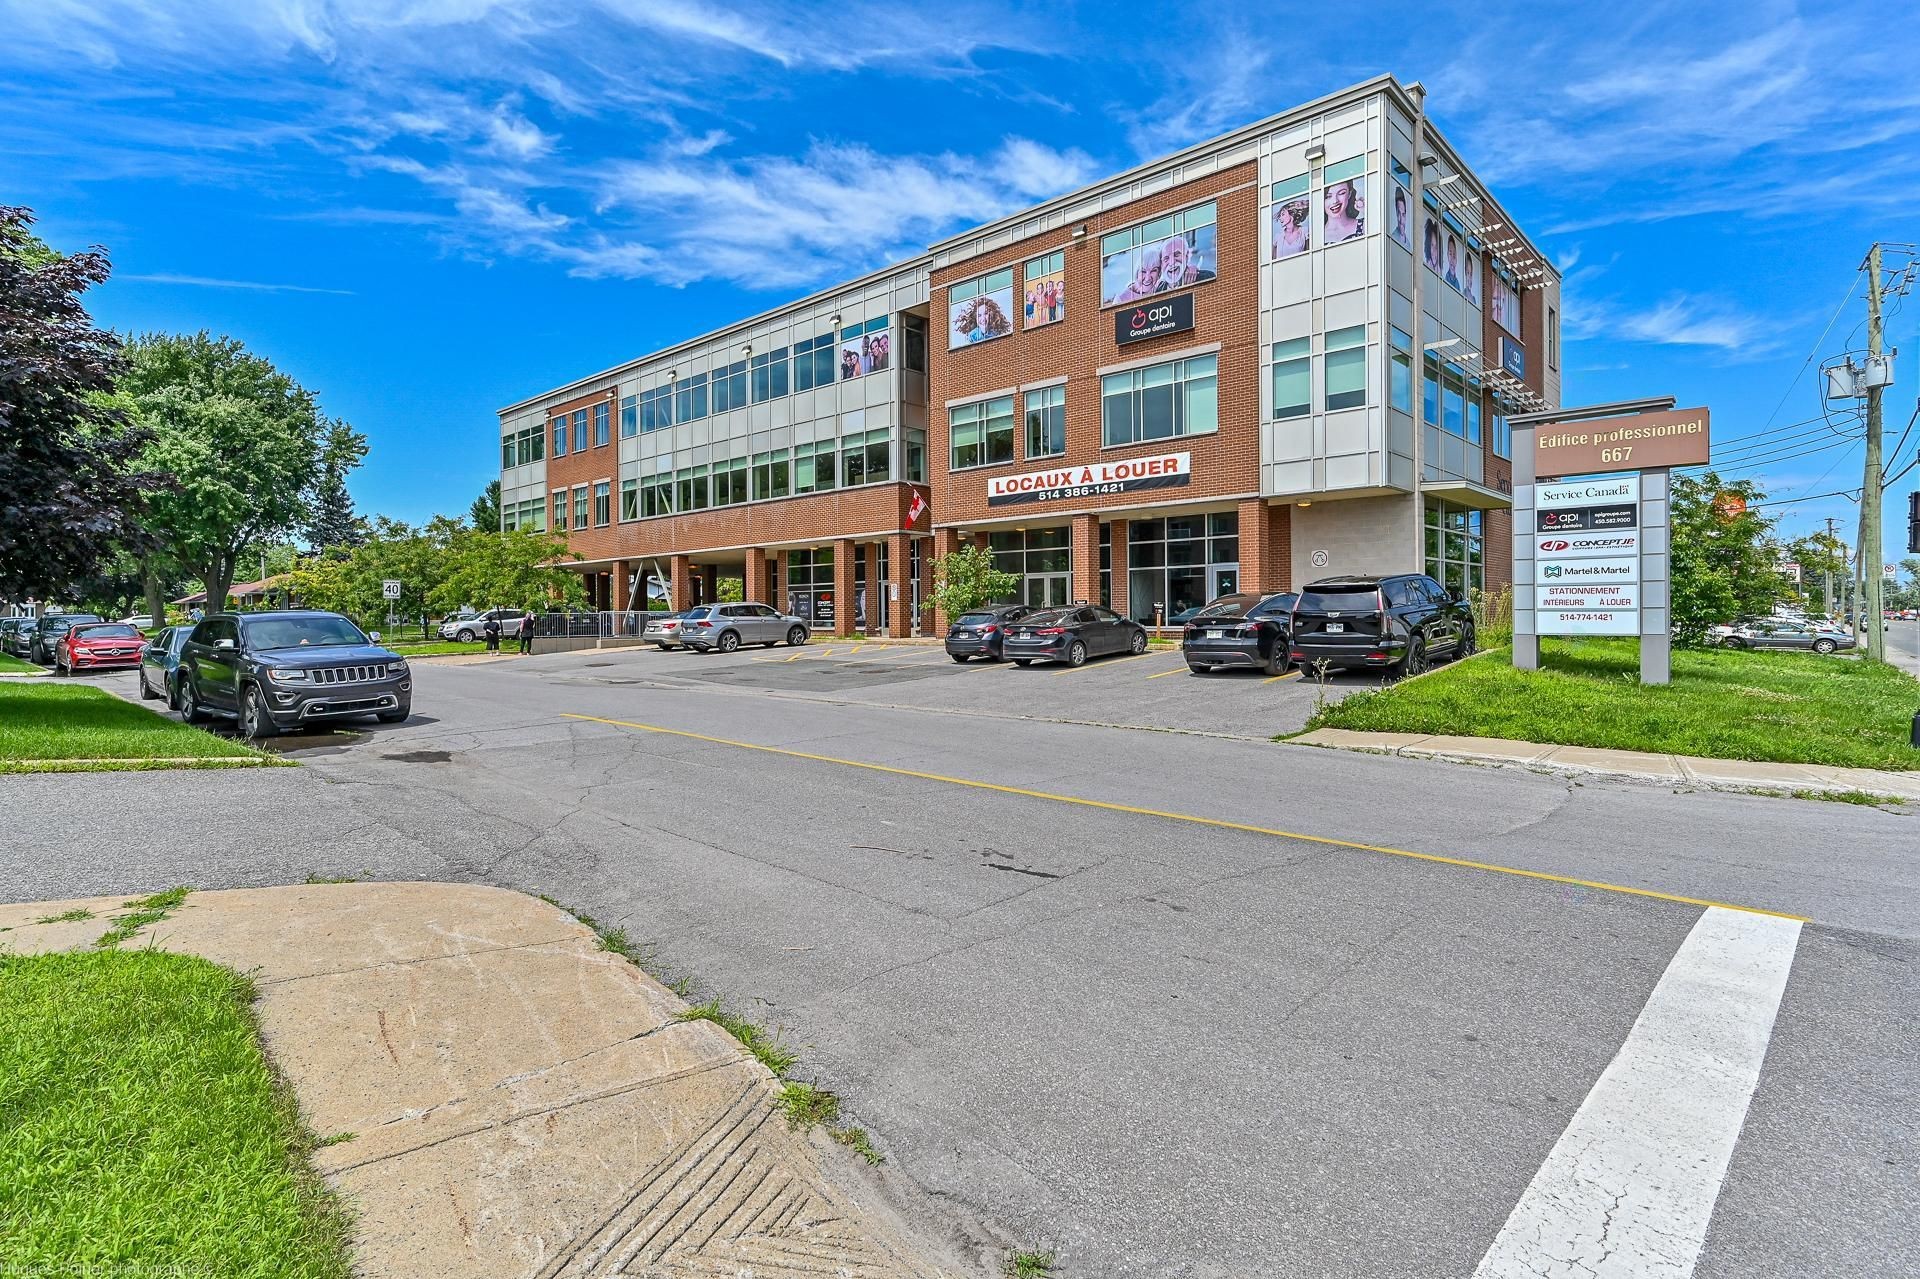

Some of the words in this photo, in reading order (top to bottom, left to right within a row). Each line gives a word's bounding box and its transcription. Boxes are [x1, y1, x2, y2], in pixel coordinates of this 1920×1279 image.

[1148, 305, 1172, 323] api
[1129, 325, 1151, 338] Groupe
[1152, 320, 1176, 332] dentaire
[1539, 433, 1588, 449] Édifice
[1594, 419, 1702, 446] professionnel
[1601, 446, 1633, 463] 667
[995, 471, 1072, 494] LOCAUX
[1080, 466, 1094, 484] À
[1102, 458, 1178, 481] LOUER
[1038, 489, 1060, 501] 514
[1065, 483, 1124, 497] 386-1421
[1543, 490, 1582, 501] Service
[1585, 485, 1629, 497] Canada
[384, 584, 399, 595] 40
[1543, 598, 1585, 606] INTÉRIEURS
[1606, 598, 1631, 606] LOUER
[1559, 613, 1613, 621] 514-774-1421
